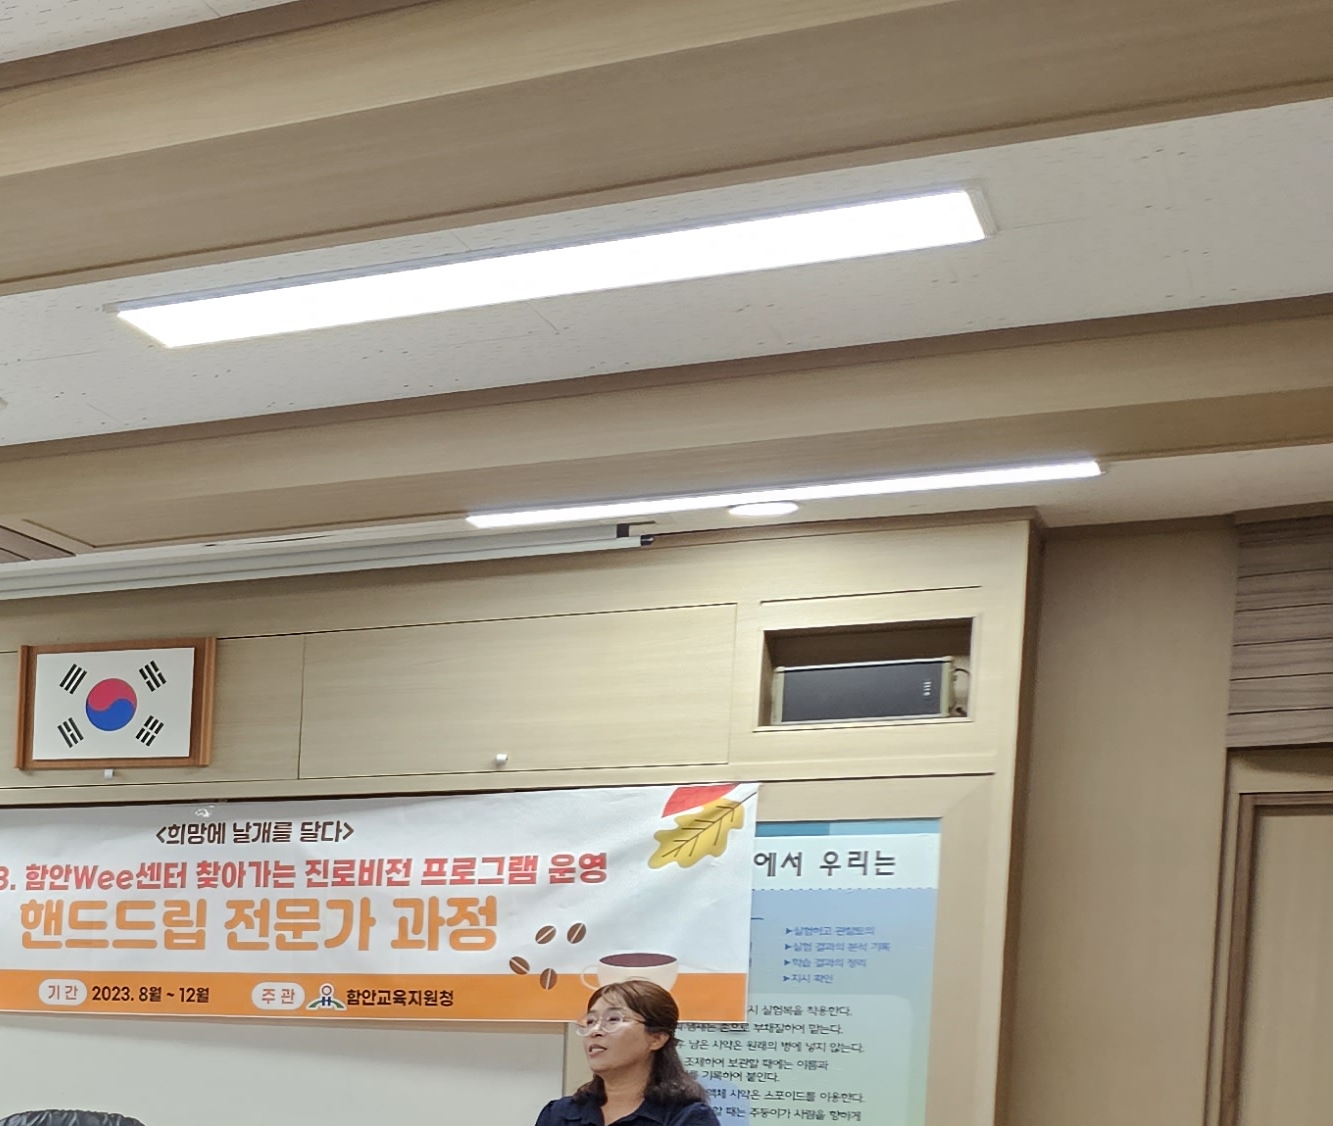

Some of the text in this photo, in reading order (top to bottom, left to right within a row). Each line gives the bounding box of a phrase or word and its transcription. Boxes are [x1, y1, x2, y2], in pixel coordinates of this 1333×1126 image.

[155, 820, 355, 845] <희망에 날개를 달다>
[819, 850, 896, 876] 우리는
[25, 861, 188, 891] 함안Wee센터
[196, 859, 296, 889] 찾아가는
[305, 857, 413, 888] 진로비전
[421, 855, 538, 886] 프로그램
[548, 852, 607, 884] 운영
[19, 895, 498, 951] 핸드드립 전문가 과정
[92, 986, 134, 1001] 2023.
[139, 986, 162, 1002] 8월
[179, 987, 210, 1003] 12월
[346, 989, 454, 1007] 함안교육지원청
[762, 1005, 803, 1016] 실험복을
[808, 1006, 852, 1016] 착용한다.
[754, 1023, 805, 1034] 부채질하여
[689, 1040, 709, 1050] 남은
[713, 1040, 743, 1051] 시약은
[747, 1041, 777, 1052] 원래의
[781, 1042, 802, 1052] 병에
[830, 1042, 865, 1053] 않는다.
[684, 1057, 829, 1070] 조제하여 보관할 때에는 이름과
[702, 1071, 743, 1081] 기록하여
[746, 1071, 780, 1082] 붙인다.
[730, 1089, 760, 1100] 시약은
[764, 1090, 815, 1102] 스포이드를
[820, 1091, 865, 1103] 이용한다.
[726, 1107, 746, 1117] 때는
[749, 1108, 791, 1119] 주둥이가
[794, 1109, 826, 1120] 사람을
[829, 1110, 861, 1121] 향하게
